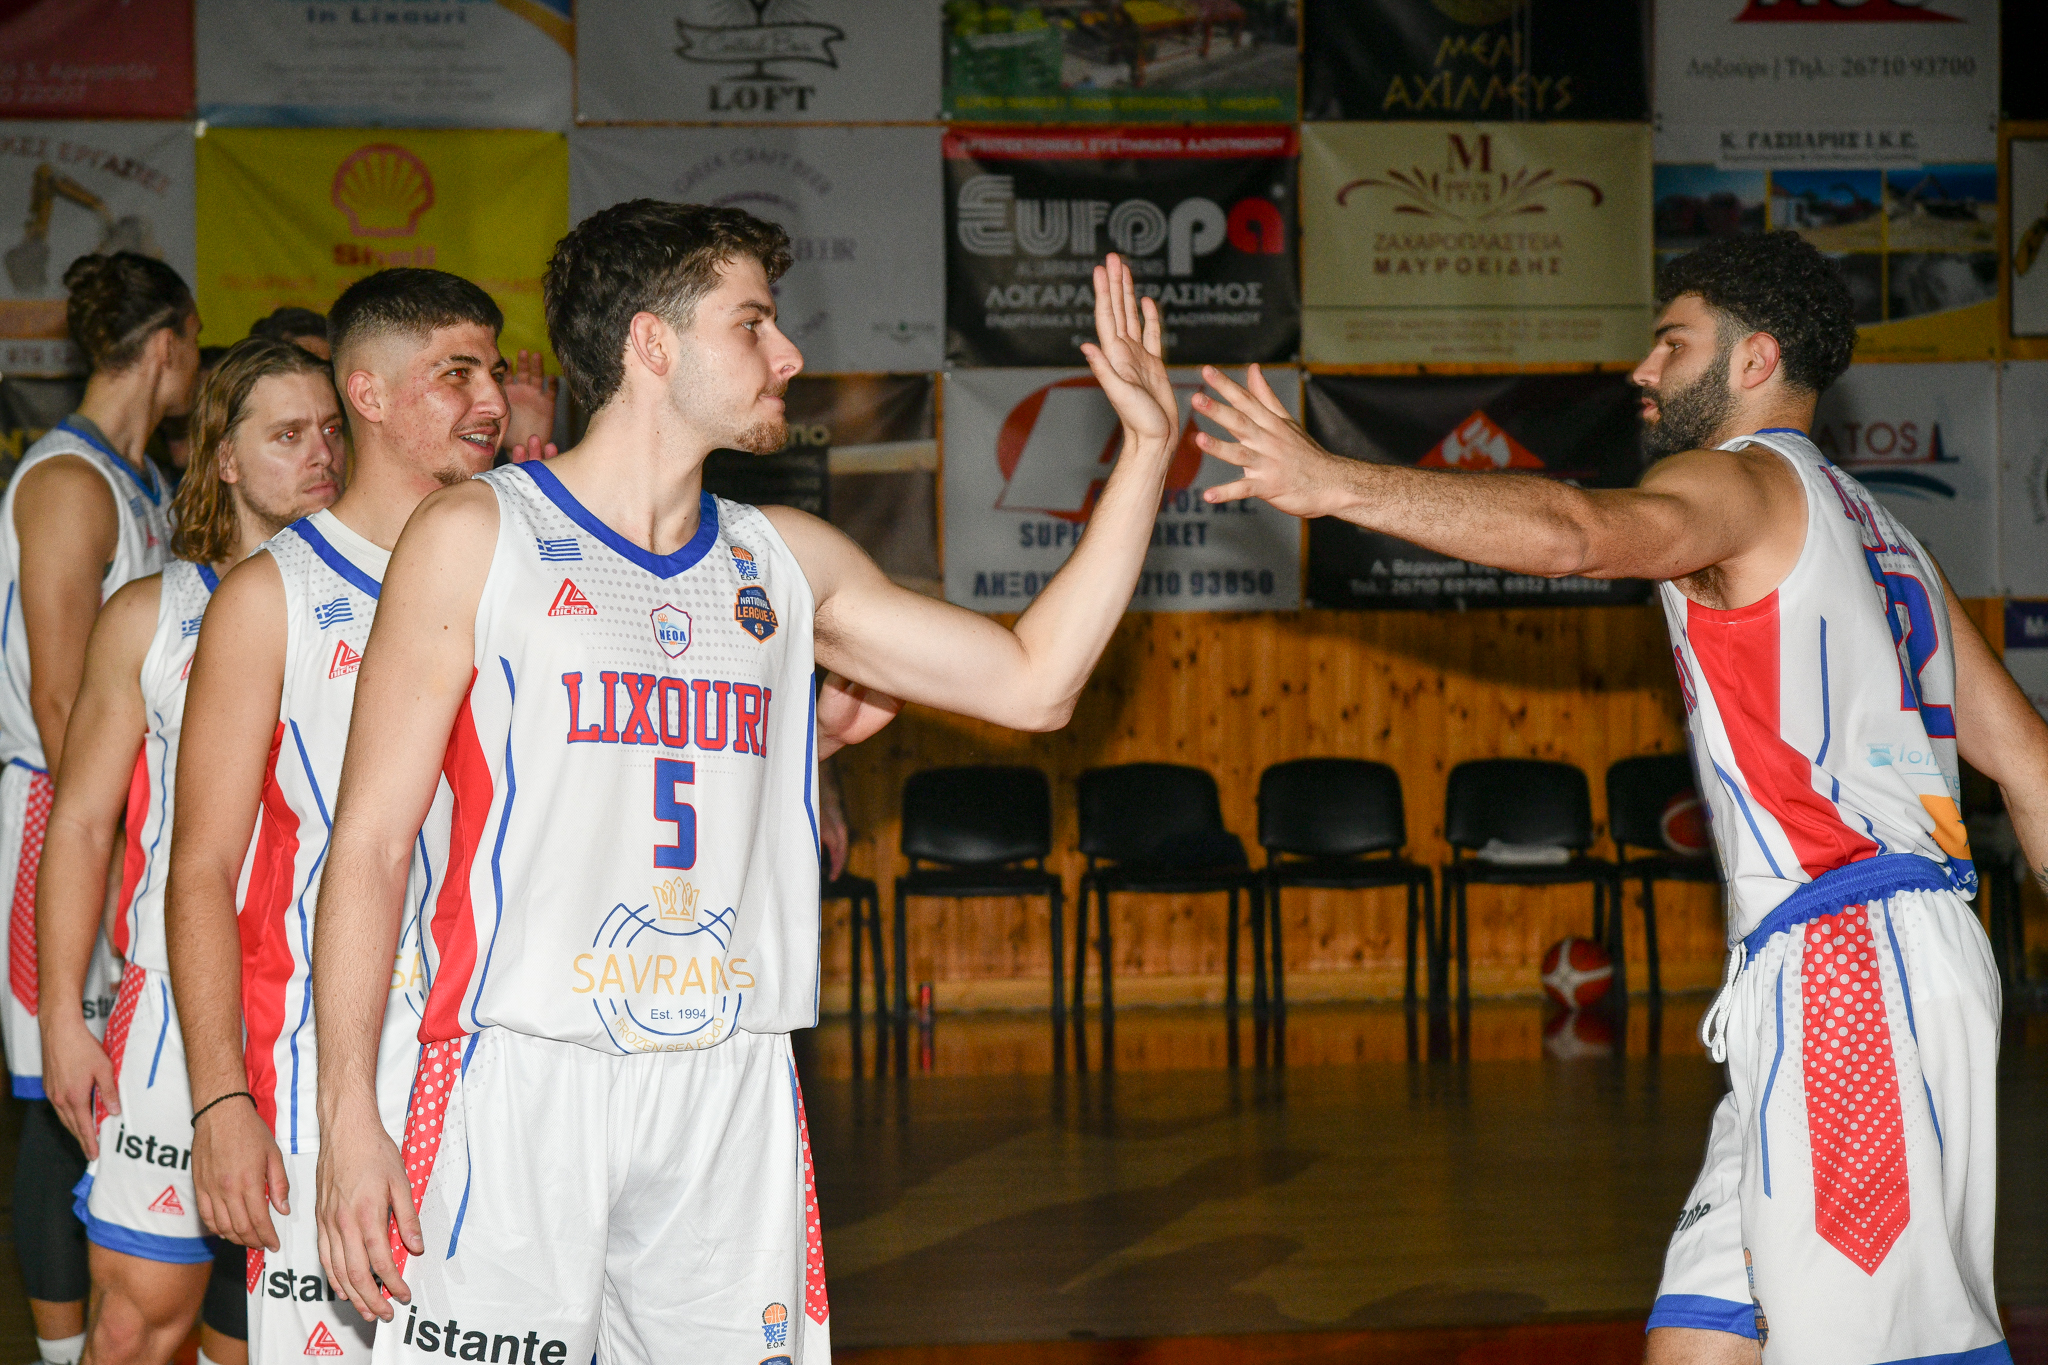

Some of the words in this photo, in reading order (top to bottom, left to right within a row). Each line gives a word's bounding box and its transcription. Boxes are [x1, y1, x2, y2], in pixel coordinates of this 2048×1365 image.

[708, 85, 817, 112] LOFT
[1447, 132, 1494, 173] M
[331, 243, 437, 267] Shell
[1372, 256, 1563, 276] ΜΑΥΡΟΕΙΔΗΣ
[984, 282, 1098, 307] ΛΟΓΑΡΑ
[1134, 281, 1264, 307] ΕΡΑΣΙΜΟΣ
[1020, 521, 1082, 549] SUPE
[550, 606, 595, 616] nickan
[737, 606, 770, 622] LEAGUE
[740, 596, 770, 610] NATIONAL
[330, 663, 361, 679] nicka
[562, 671, 772, 759] LIXOURI
[653, 757, 697, 871] 5
[650, 1008, 673, 1020] Est.
[678, 1008, 707, 1020] 1994
[615, 1017, 664, 1052] FROZEN
[403, 1305, 568, 1365] istante
